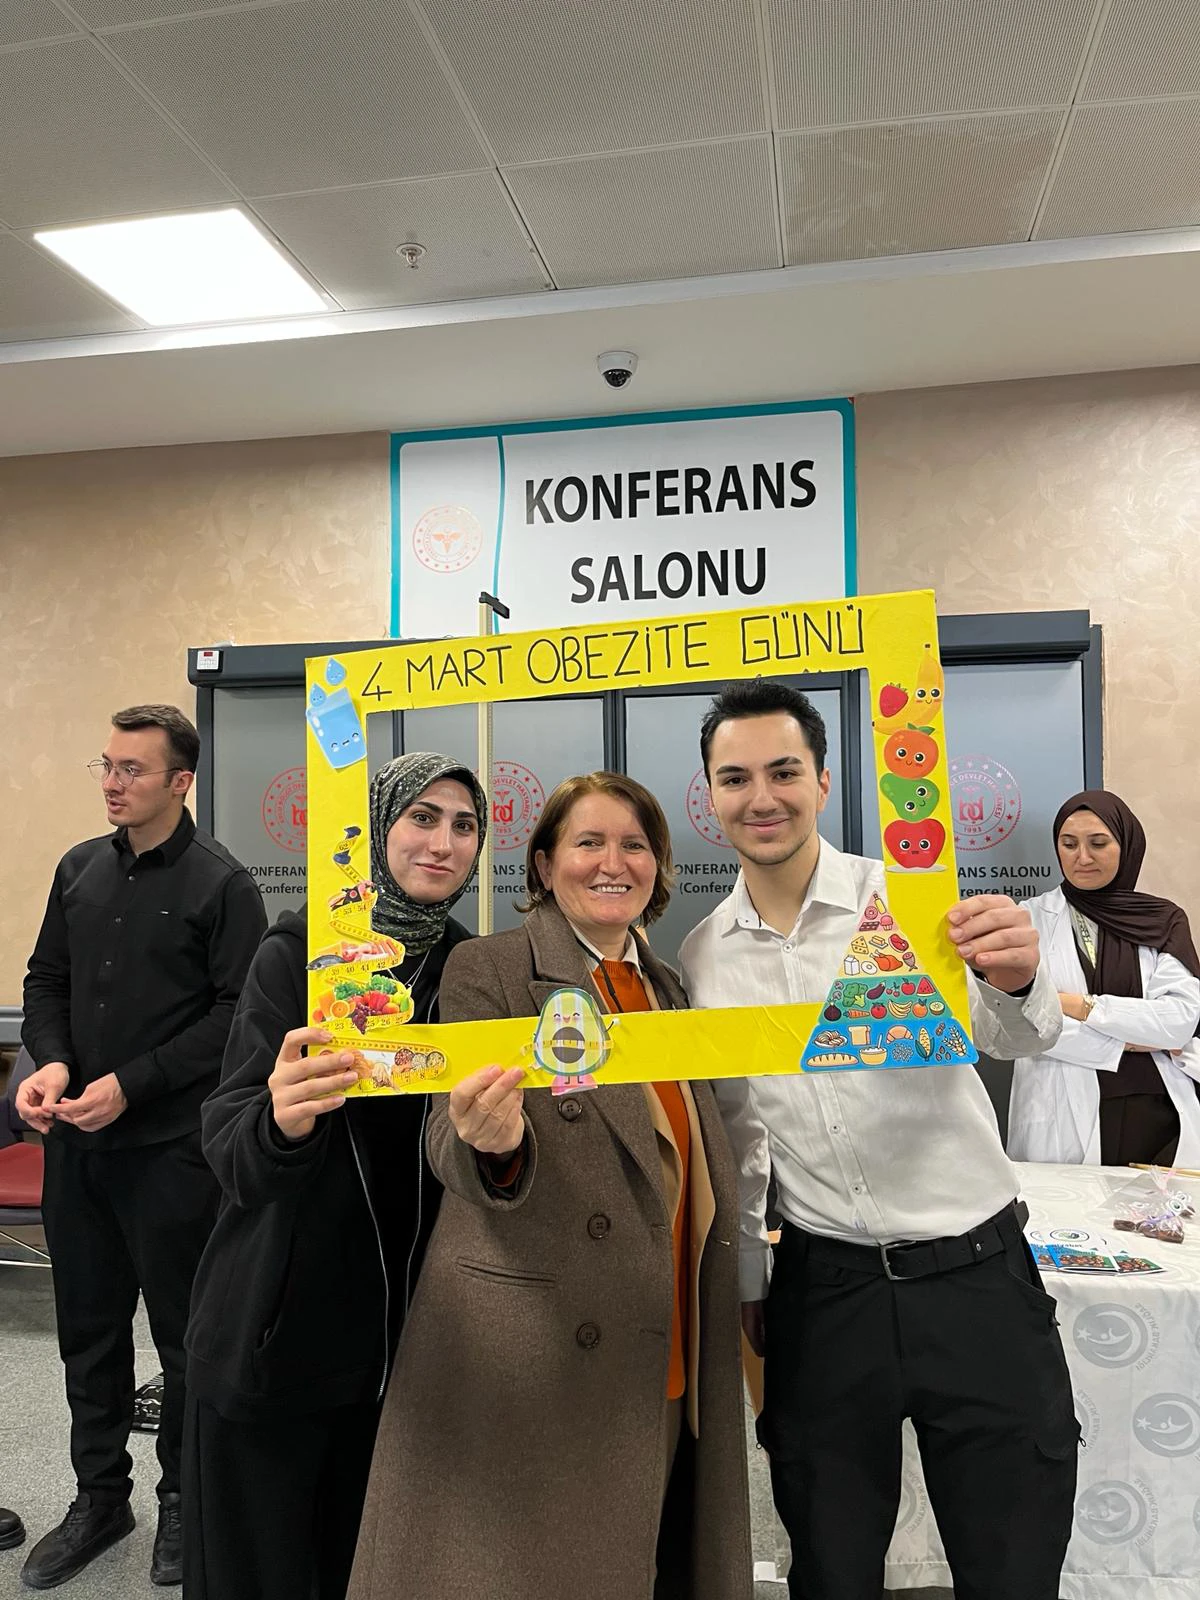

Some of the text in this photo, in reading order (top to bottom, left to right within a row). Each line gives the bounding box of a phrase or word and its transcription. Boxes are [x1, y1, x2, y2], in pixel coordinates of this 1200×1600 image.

[525, 459, 817, 525] KONFERANS
[570, 547, 767, 604] SALONU
[361, 661, 393, 702] 4
[406, 645, 513, 694] MART
[740, 604, 865, 665] GÜNÜ
[247, 866, 307, 877] ONFERAN
[674, 863, 742, 875] ONFERAN
[990, 866, 1051, 878] SALONU
[1003, 885, 1037, 898] Hall)
